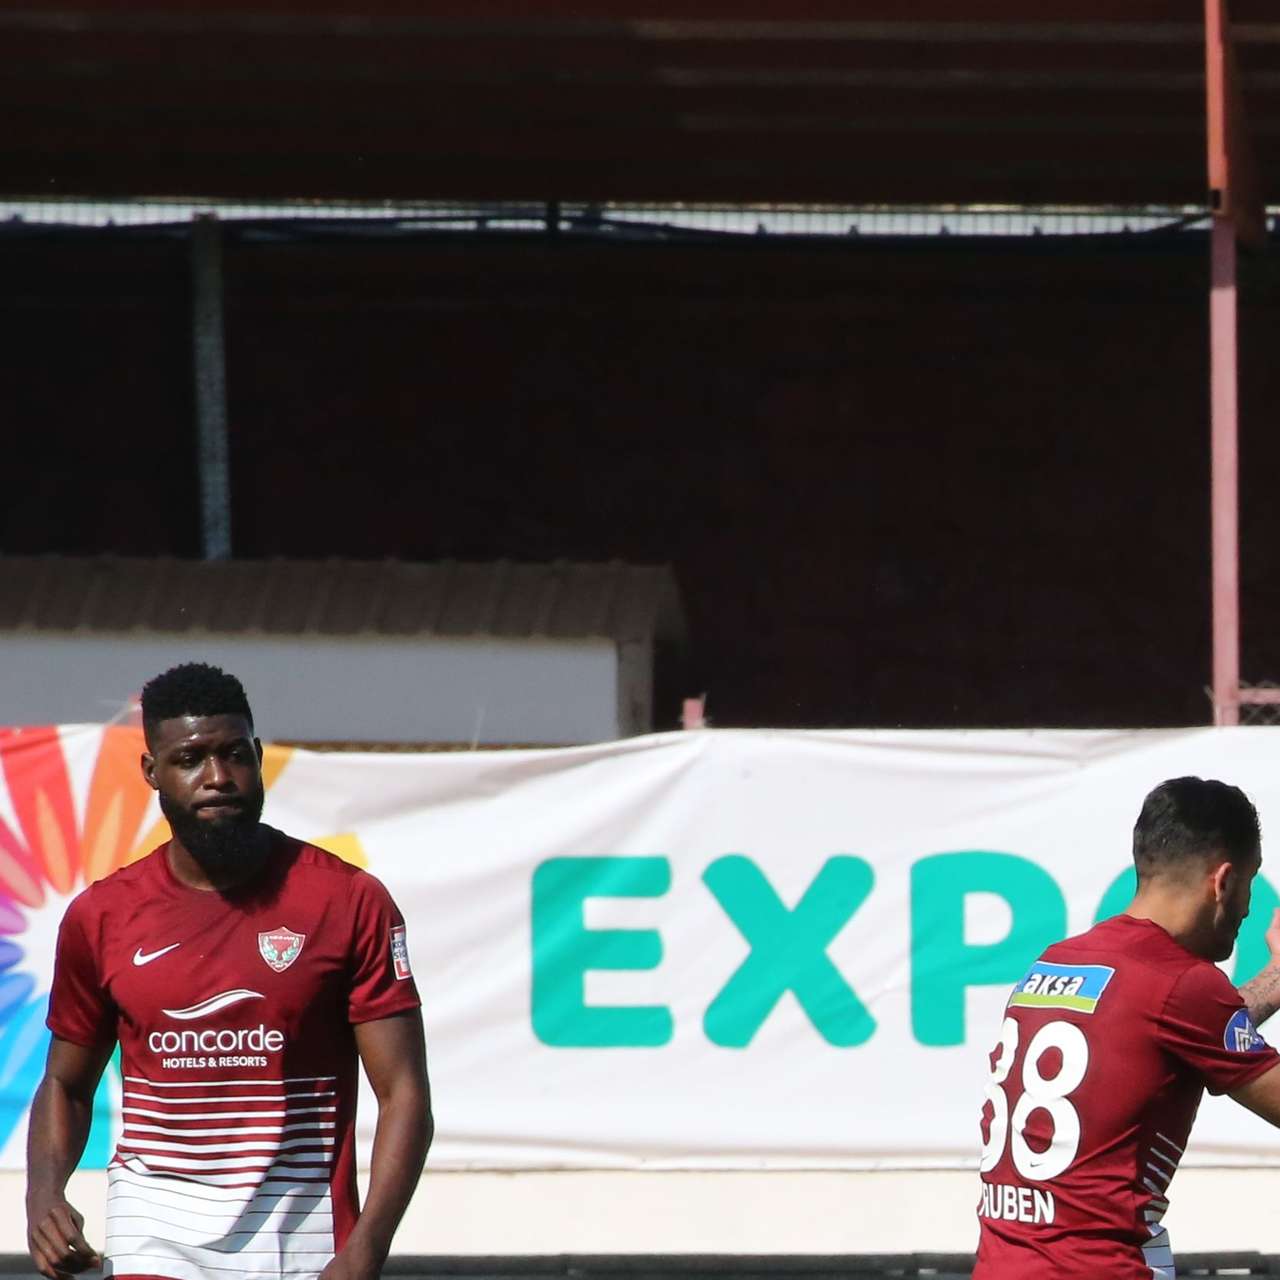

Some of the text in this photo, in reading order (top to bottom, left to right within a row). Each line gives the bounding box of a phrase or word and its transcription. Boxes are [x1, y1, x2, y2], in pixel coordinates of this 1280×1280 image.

[1023, 972, 1084, 996] aksa
[148, 1023, 284, 1053] concorde
[162, 1055, 268, 1069] HOTELS & RESORTS
